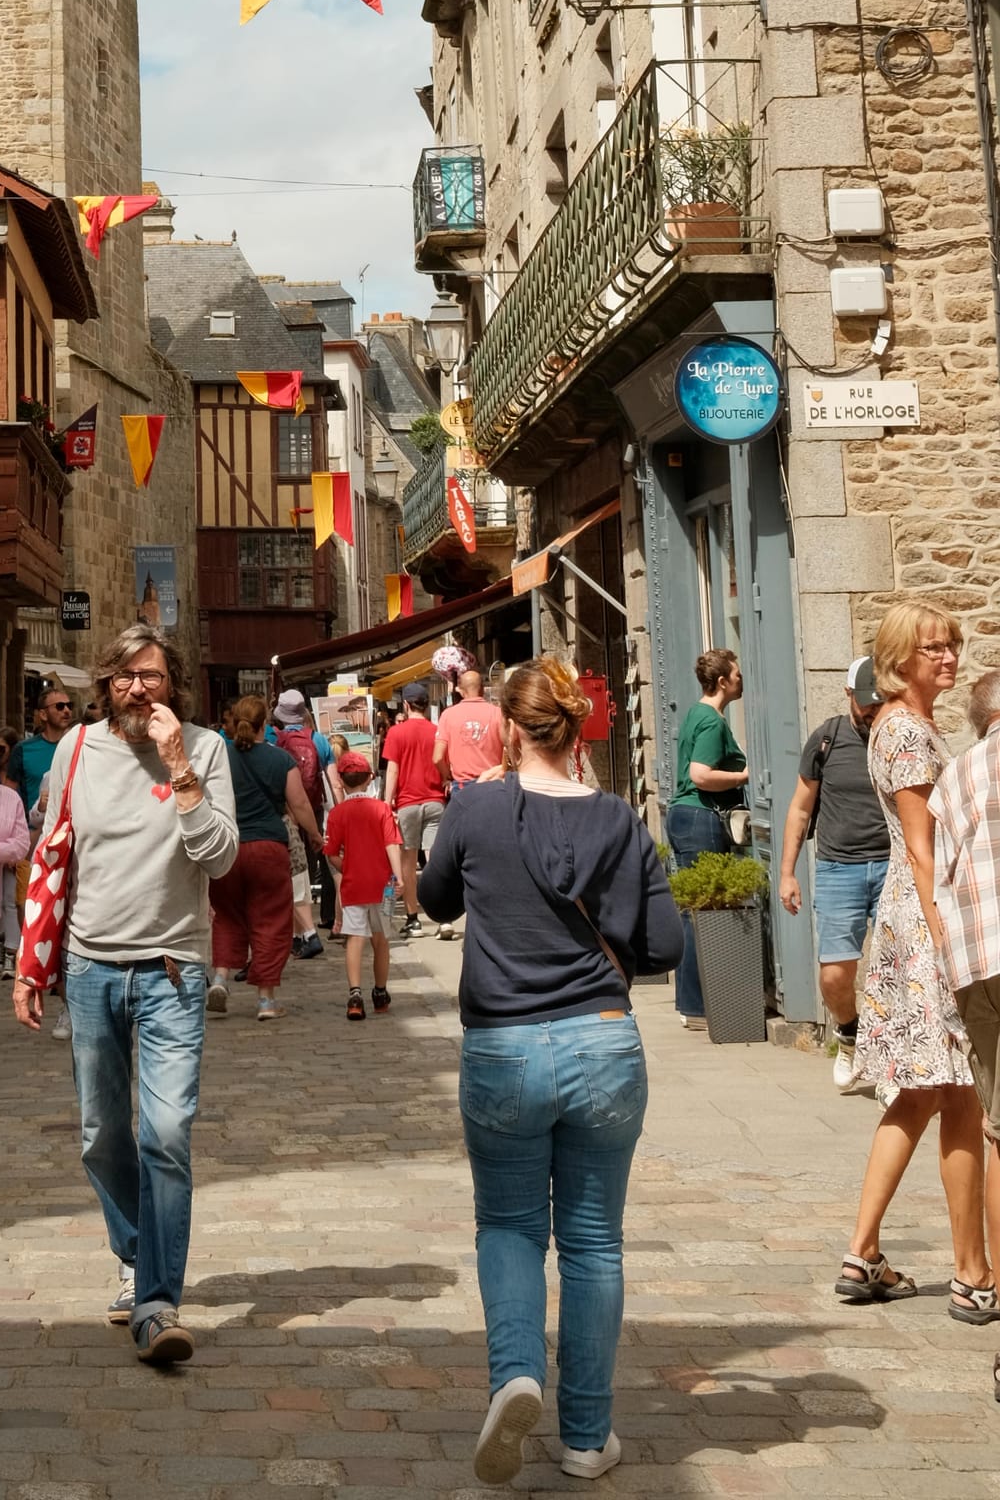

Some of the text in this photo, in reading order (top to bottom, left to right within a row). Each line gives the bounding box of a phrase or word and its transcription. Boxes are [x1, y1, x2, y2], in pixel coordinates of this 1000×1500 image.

[687, 362, 765, 382] La Pierre
[715, 380, 774, 400] de Lune
[849, 388, 873, 398] RUE
[699, 409, 765, 419] BIJOUTERIE
[810, 405, 915, 419] DE L'HORLOGE
[449, 416, 460, 425] LE
[450, 487, 473, 543] TABAC
